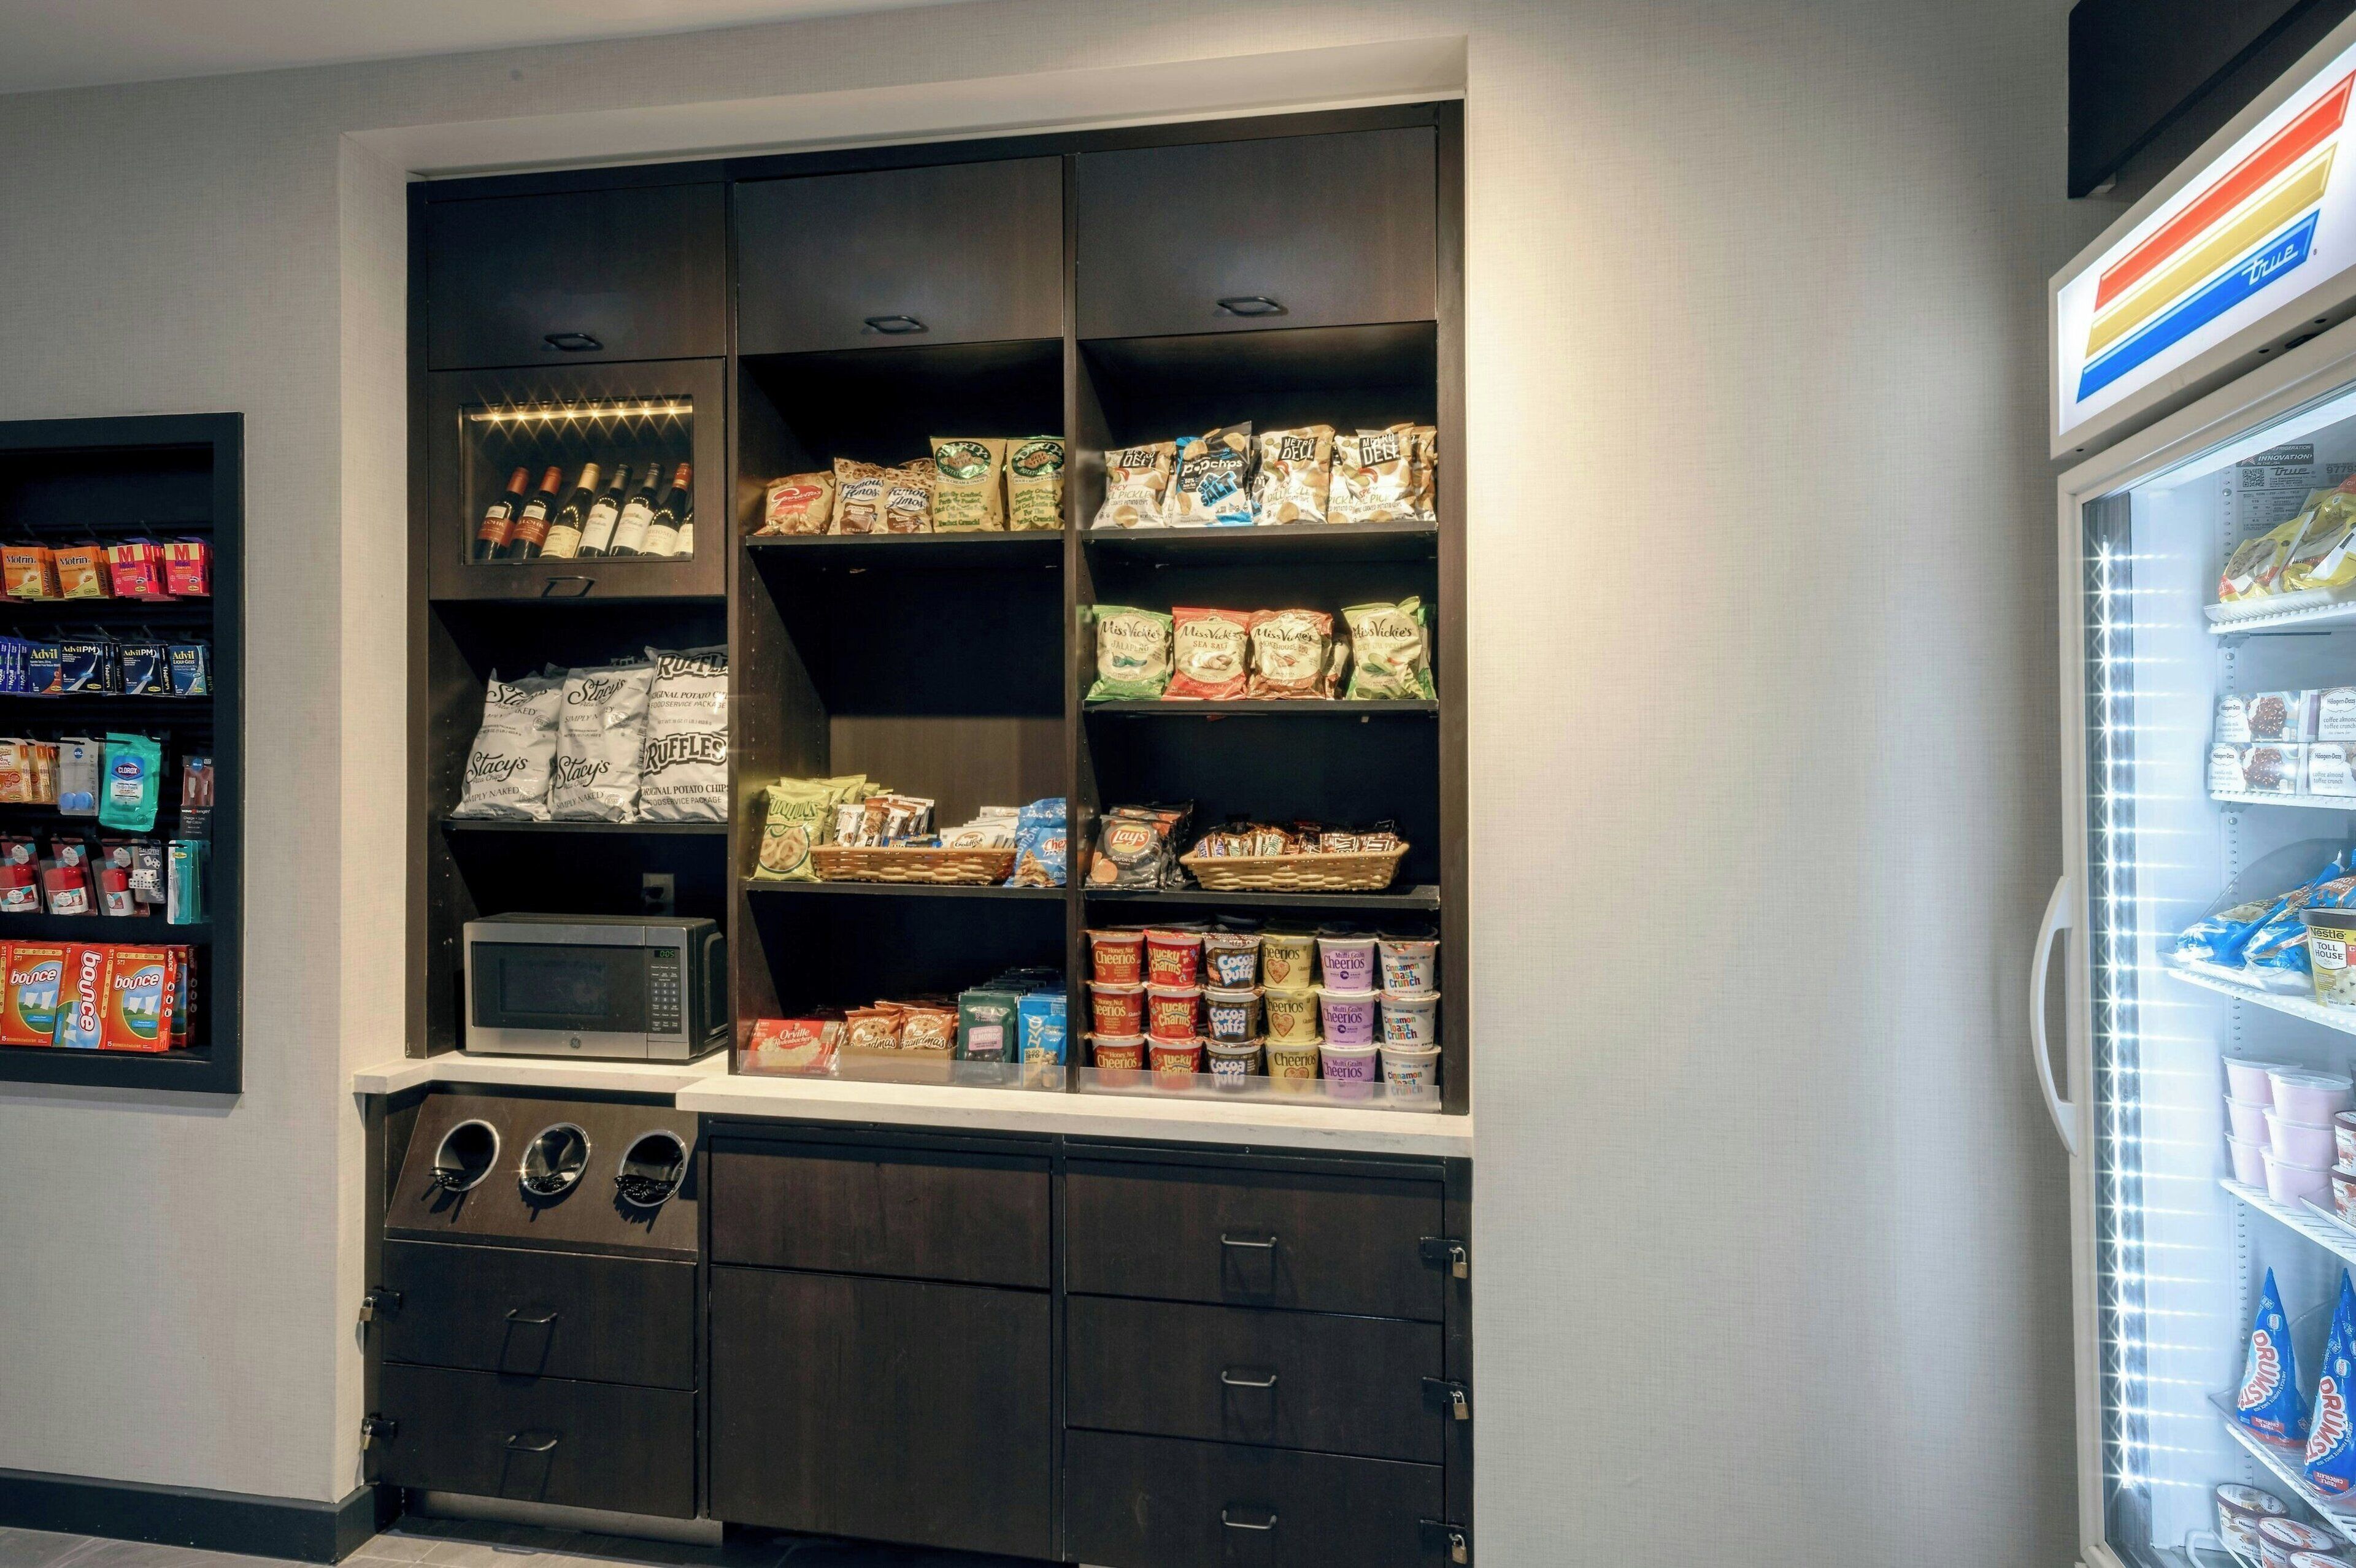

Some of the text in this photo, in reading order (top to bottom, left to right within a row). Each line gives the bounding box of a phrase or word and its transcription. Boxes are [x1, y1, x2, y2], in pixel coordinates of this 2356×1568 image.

[2242, 244, 2298, 285] true
[1284, 438, 1314, 448] METRO
[1363, 433, 1394, 447] METRO
[839, 477, 885, 493] Famous
[1201, 472, 1235, 507] SALT
[839, 488, 880, 503] Amos
[888, 487, 930, 501] Famous
[1118, 491, 1152, 499] PICKLE
[885, 496, 926, 509] Amos
[522, 520, 544, 529] LOHR
[117, 545, 135, 563] M
[174, 544, 191, 561] M
[6, 555, 34, 564] Motrin
[60, 555, 88, 566] Motrin
[1099, 620, 1126, 637] Miss
[1180, 626, 1207, 639] Miss
[1253, 628, 1280, 640] Miss
[1352, 618, 1414, 642] Miss Vickie's
[31, 648, 58, 659] Advil
[172, 650, 195, 659] Advil
[1298, 644, 1308, 654] BBQ
[567, 678, 626, 705] Stacy's
[650, 700, 693, 709] FOODSERVICE
[564, 715, 590, 723] SIMPLY
[645, 734, 725, 771] RUFFLES
[466, 751, 528, 784] Stacy's
[555, 756, 610, 790] Stacy's
[485, 773, 503, 783] Chips
[489, 786, 520, 798] NAKED
[673, 785, 704, 794] POTATO
[556, 791, 604, 810] SIMPLY NAKED
[647, 797, 690, 807] OODSERVICE
[955, 838, 983, 848] Goldfish
[2317, 942, 2338, 951] TOLL
[1096, 950, 1136, 965] Cheerios
[1153, 948, 1180, 964] Lucky
[2315, 950, 2344, 960] HOUSE
[1151, 959, 1182, 975] Charms
[1217, 954, 1255, 970] Cocoa
[1324, 955, 1365, 969] Cheerios
[1385, 963, 1420, 972] Cinnamon
[10, 969, 58, 986] bounce
[1220, 967, 1253, 986] Puffs
[1389, 975, 1421, 988] Crunch
[1392, 970, 1414, 980] Toast
[114, 972, 161, 992] bounce
[77, 950, 103, 1032] bounce
[1161, 1002, 1190, 1015] Lucky
[1209, 1007, 1247, 1022] Cocoa
[931, 1016, 943, 1025] CHIP
[1158, 1014, 1191, 1027] Charms
[1323, 1008, 1363, 1023] Cheerios
[1384, 1015, 1417, 1024] Cinnamon
[779, 1028, 810, 1040] Orville
[1213, 1019, 1247, 1039] Puffs
[1388, 1023, 1411, 1032] Toast
[971, 1032, 1001, 1042] ALMONDS
[1387, 1029, 1418, 1040] Crunch
[899, 1034, 946, 1050] Grandma's
[1096, 1055, 1137, 1069] Cheerios
[1163, 1053, 1192, 1066] Lucky
[1209, 1059, 1246, 1073] Cocoa
[1274, 1052, 1316, 1067] Cheerios
[1323, 1062, 1363, 1078] Cheerios
[1387, 1071, 1422, 1080] Cinnamon
[2316, 1472, 2343, 1484] CHOCOLATE
[2320, 1478, 2338, 1488] TRIPLE
